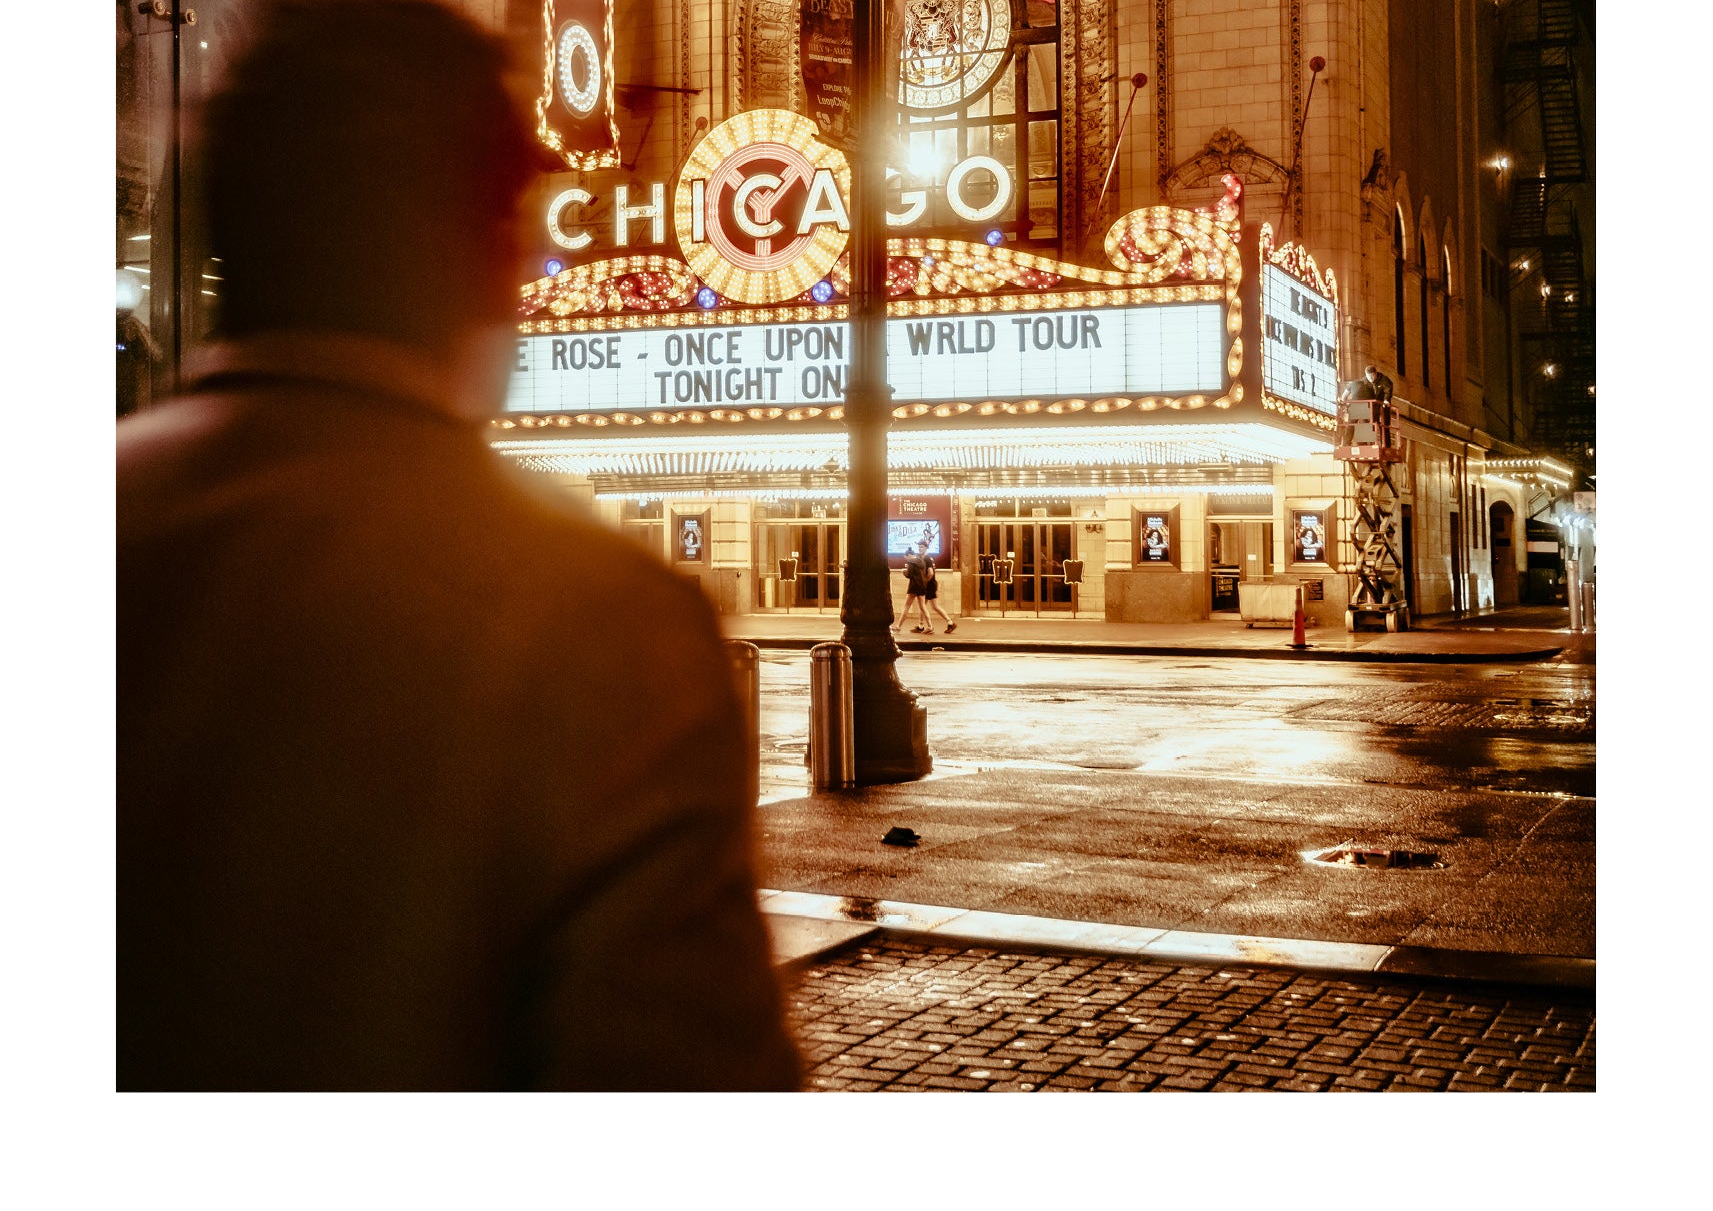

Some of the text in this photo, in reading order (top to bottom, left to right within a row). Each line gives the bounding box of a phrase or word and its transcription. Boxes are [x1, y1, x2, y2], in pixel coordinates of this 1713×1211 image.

[547, 155, 1013, 251] CHICAGO
[551, 335, 622, 371] ROSE
[664, 330, 743, 367] ONCE
[765, 326, 844, 363] UPON
[905, 318, 996, 356] WRLD
[1011, 314, 1102, 353] TOUR
[654, 367, 783, 404] TONIGHT
